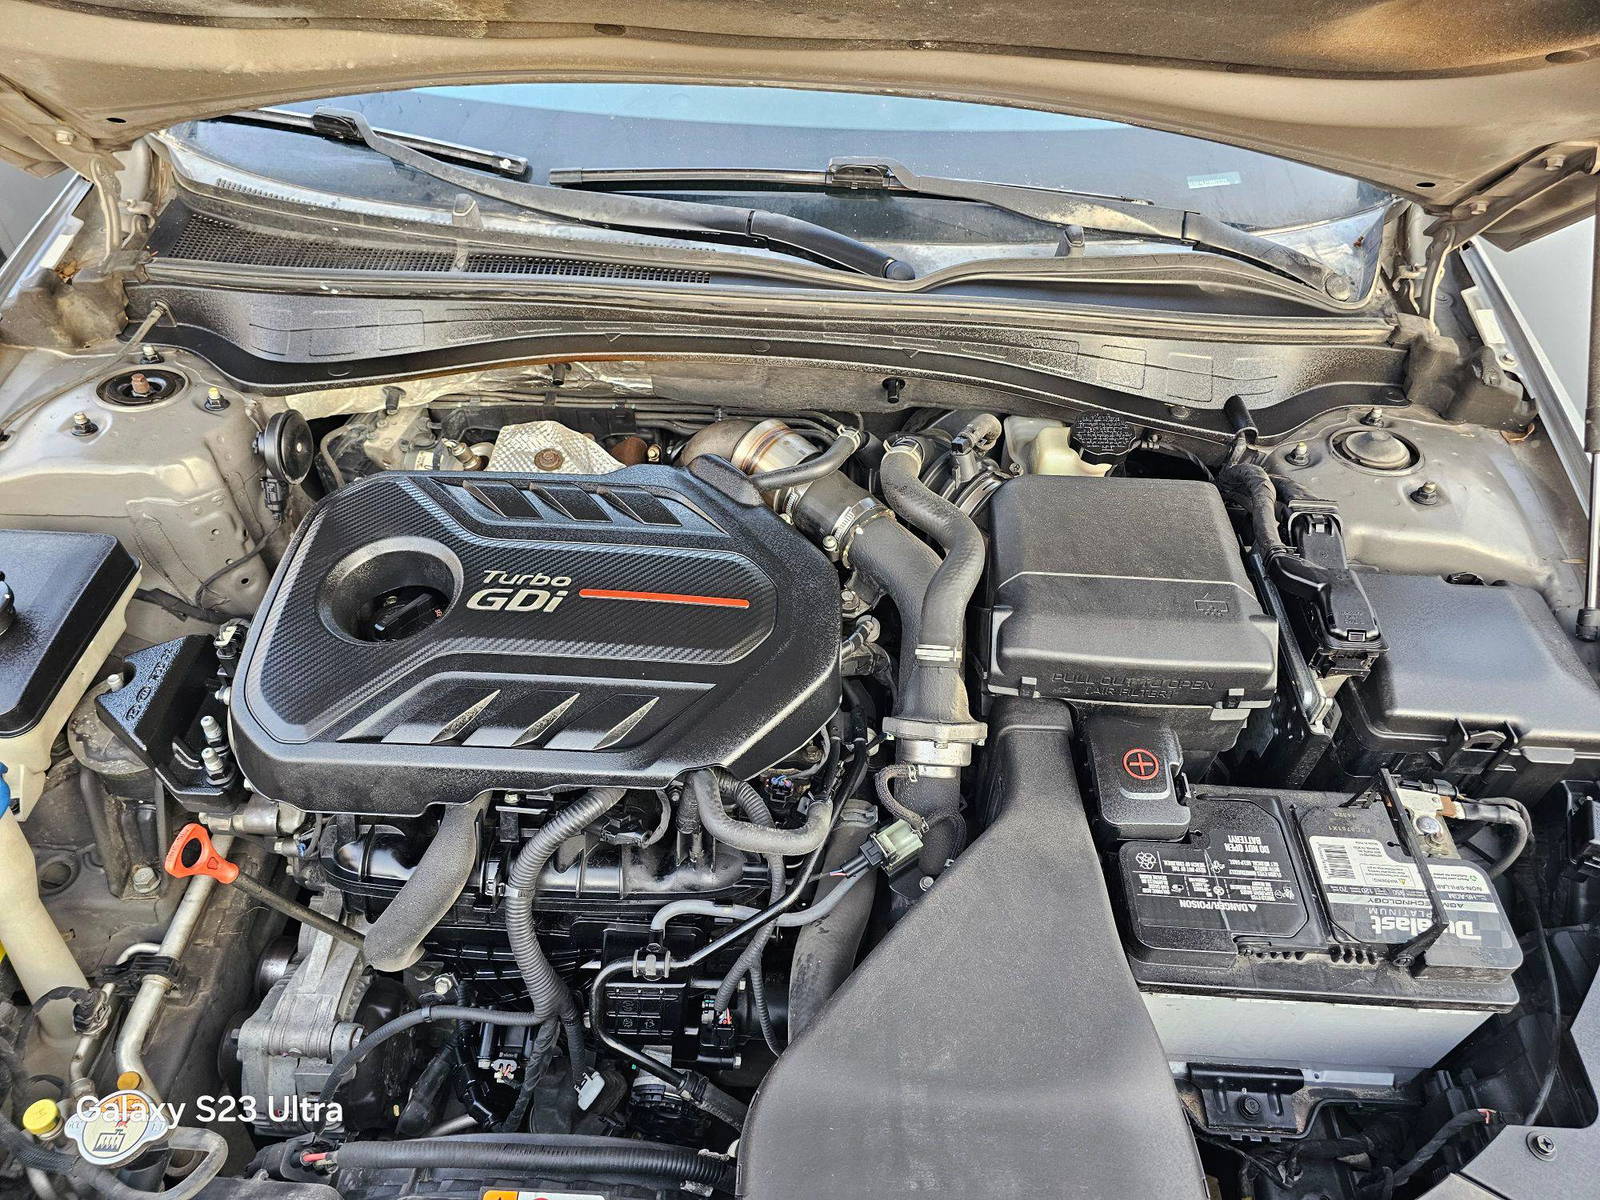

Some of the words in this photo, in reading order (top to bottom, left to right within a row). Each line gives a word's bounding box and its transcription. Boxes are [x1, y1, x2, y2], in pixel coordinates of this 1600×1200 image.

[483, 570, 572, 587] Turbo
[466, 588, 569, 613] GDi
[1051, 673, 1095, 686] PULL
[1166, 679, 1216, 691] OPEN
[1223, 842, 1243, 852] OPEN
[1244, 843, 1258, 852] NOT
[1258, 844, 1269, 853] DO
[1178, 898, 1248, 911] DANGER/POISON
[1367, 898, 1430, 906] ECHNOLOGY
[1370, 915, 1483, 940] Dualast
